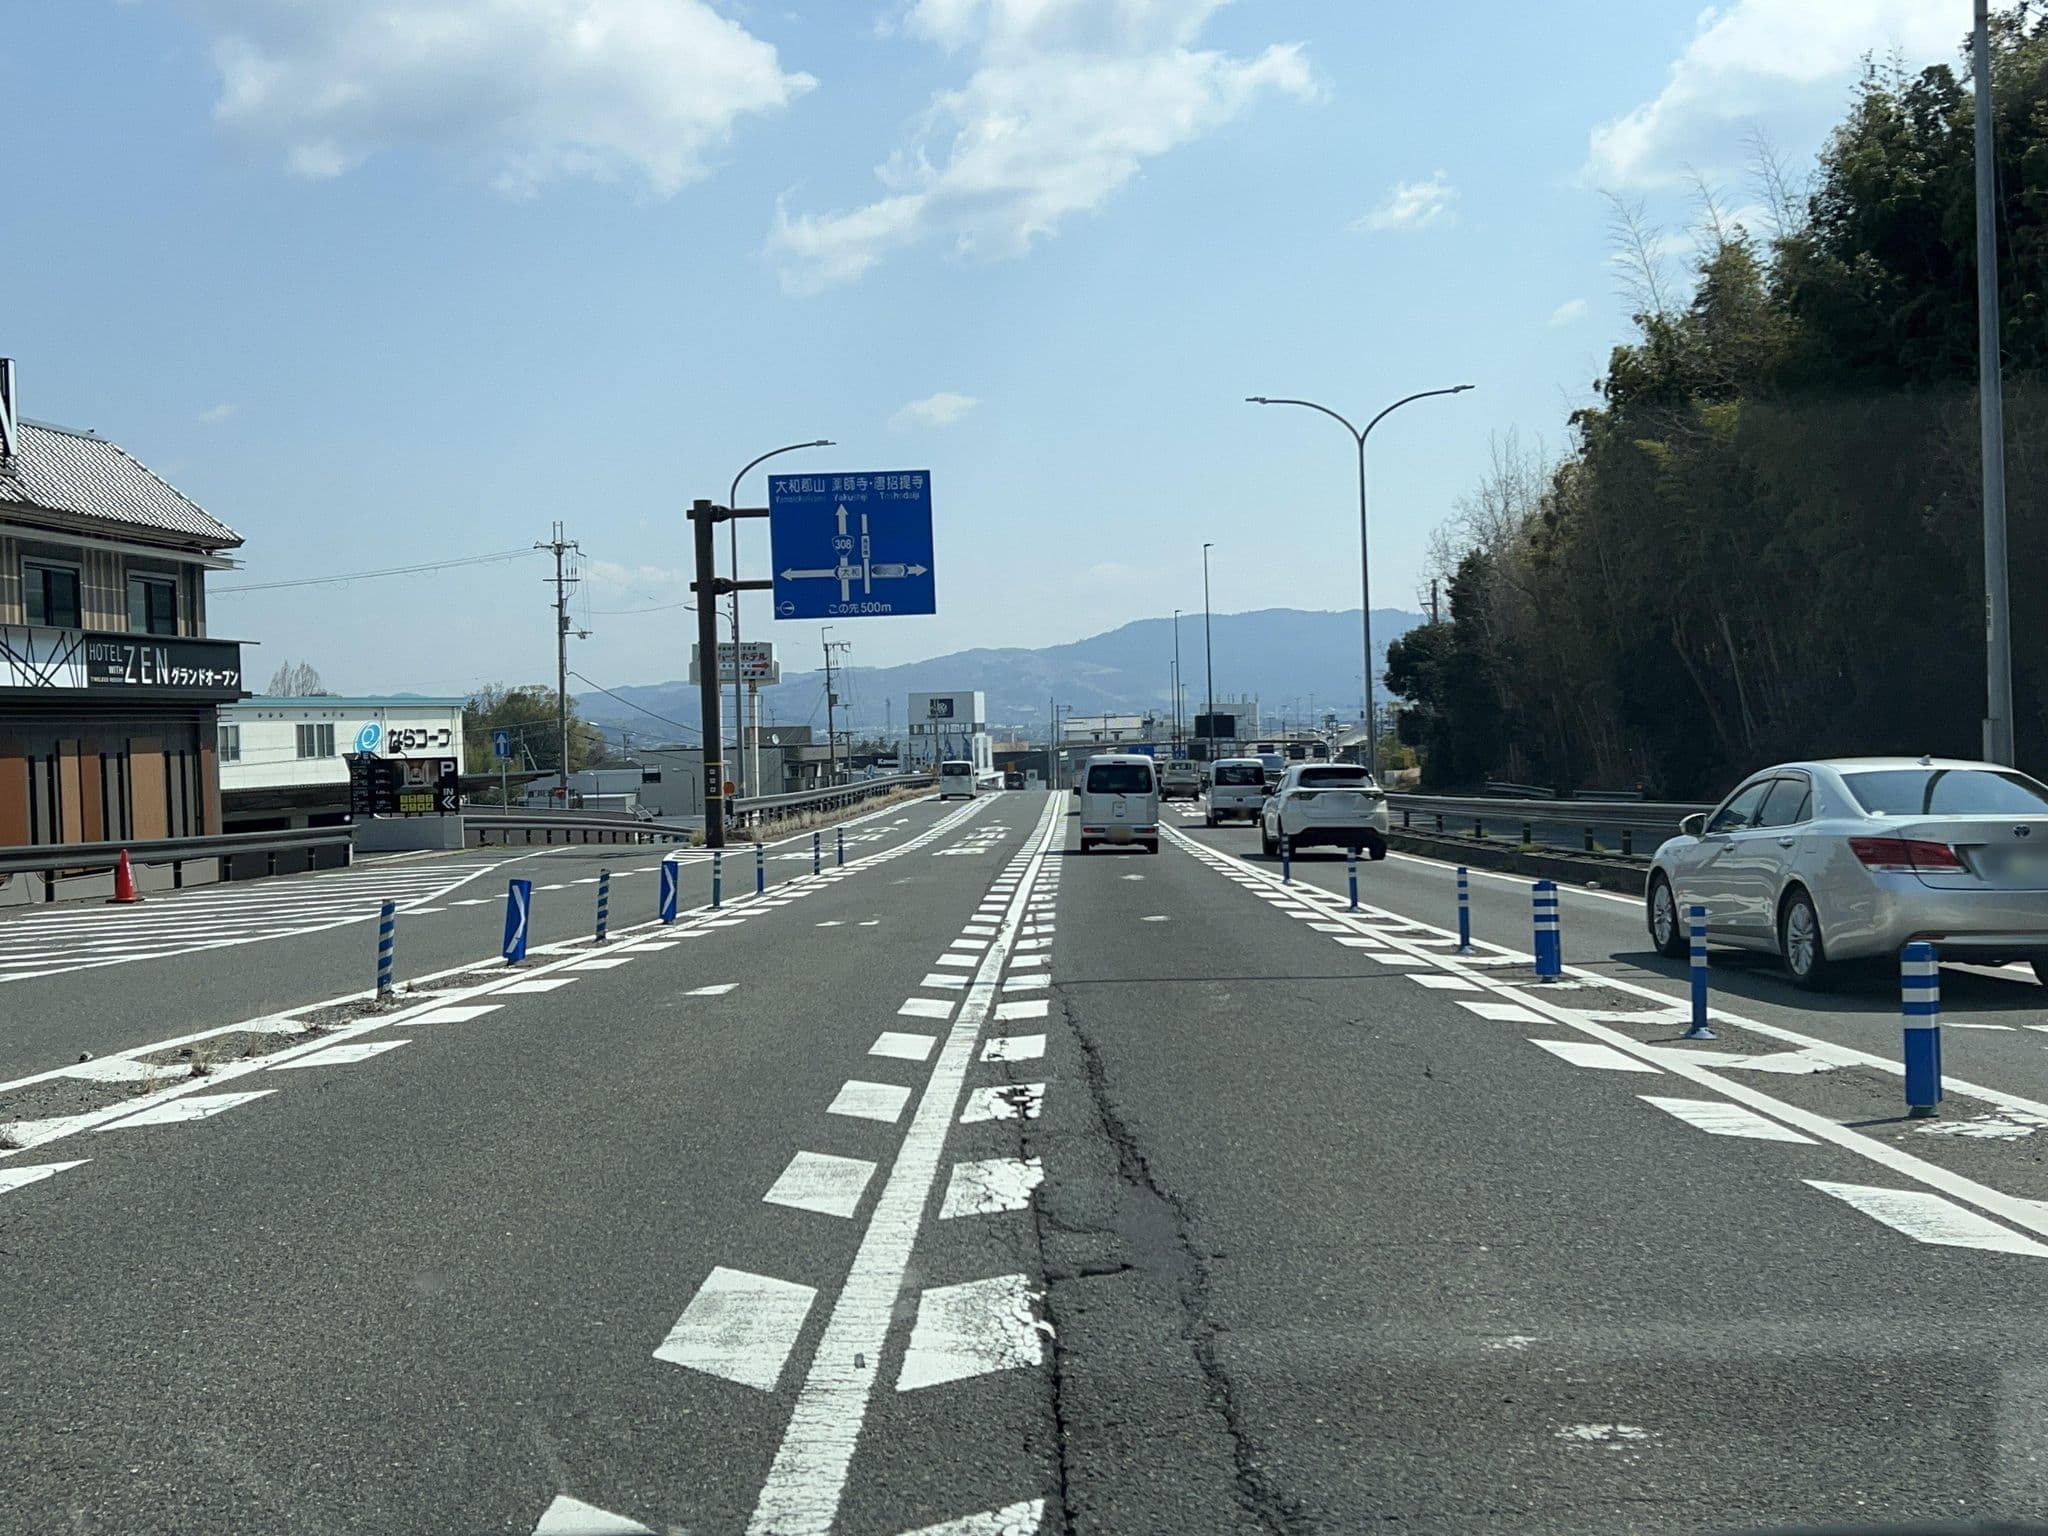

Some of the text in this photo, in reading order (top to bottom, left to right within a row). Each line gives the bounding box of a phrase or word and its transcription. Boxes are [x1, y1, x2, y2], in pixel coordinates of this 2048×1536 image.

[835, 539, 851, 550] 308
[89, 643, 123, 662] HOTEL
[123, 645, 169, 685] ZEN
[171, 666, 238, 686] グランドオープン
[388, 728, 452, 749] ならコープ
[440, 761, 455, 777] P
[443, 788, 454, 796] IN
